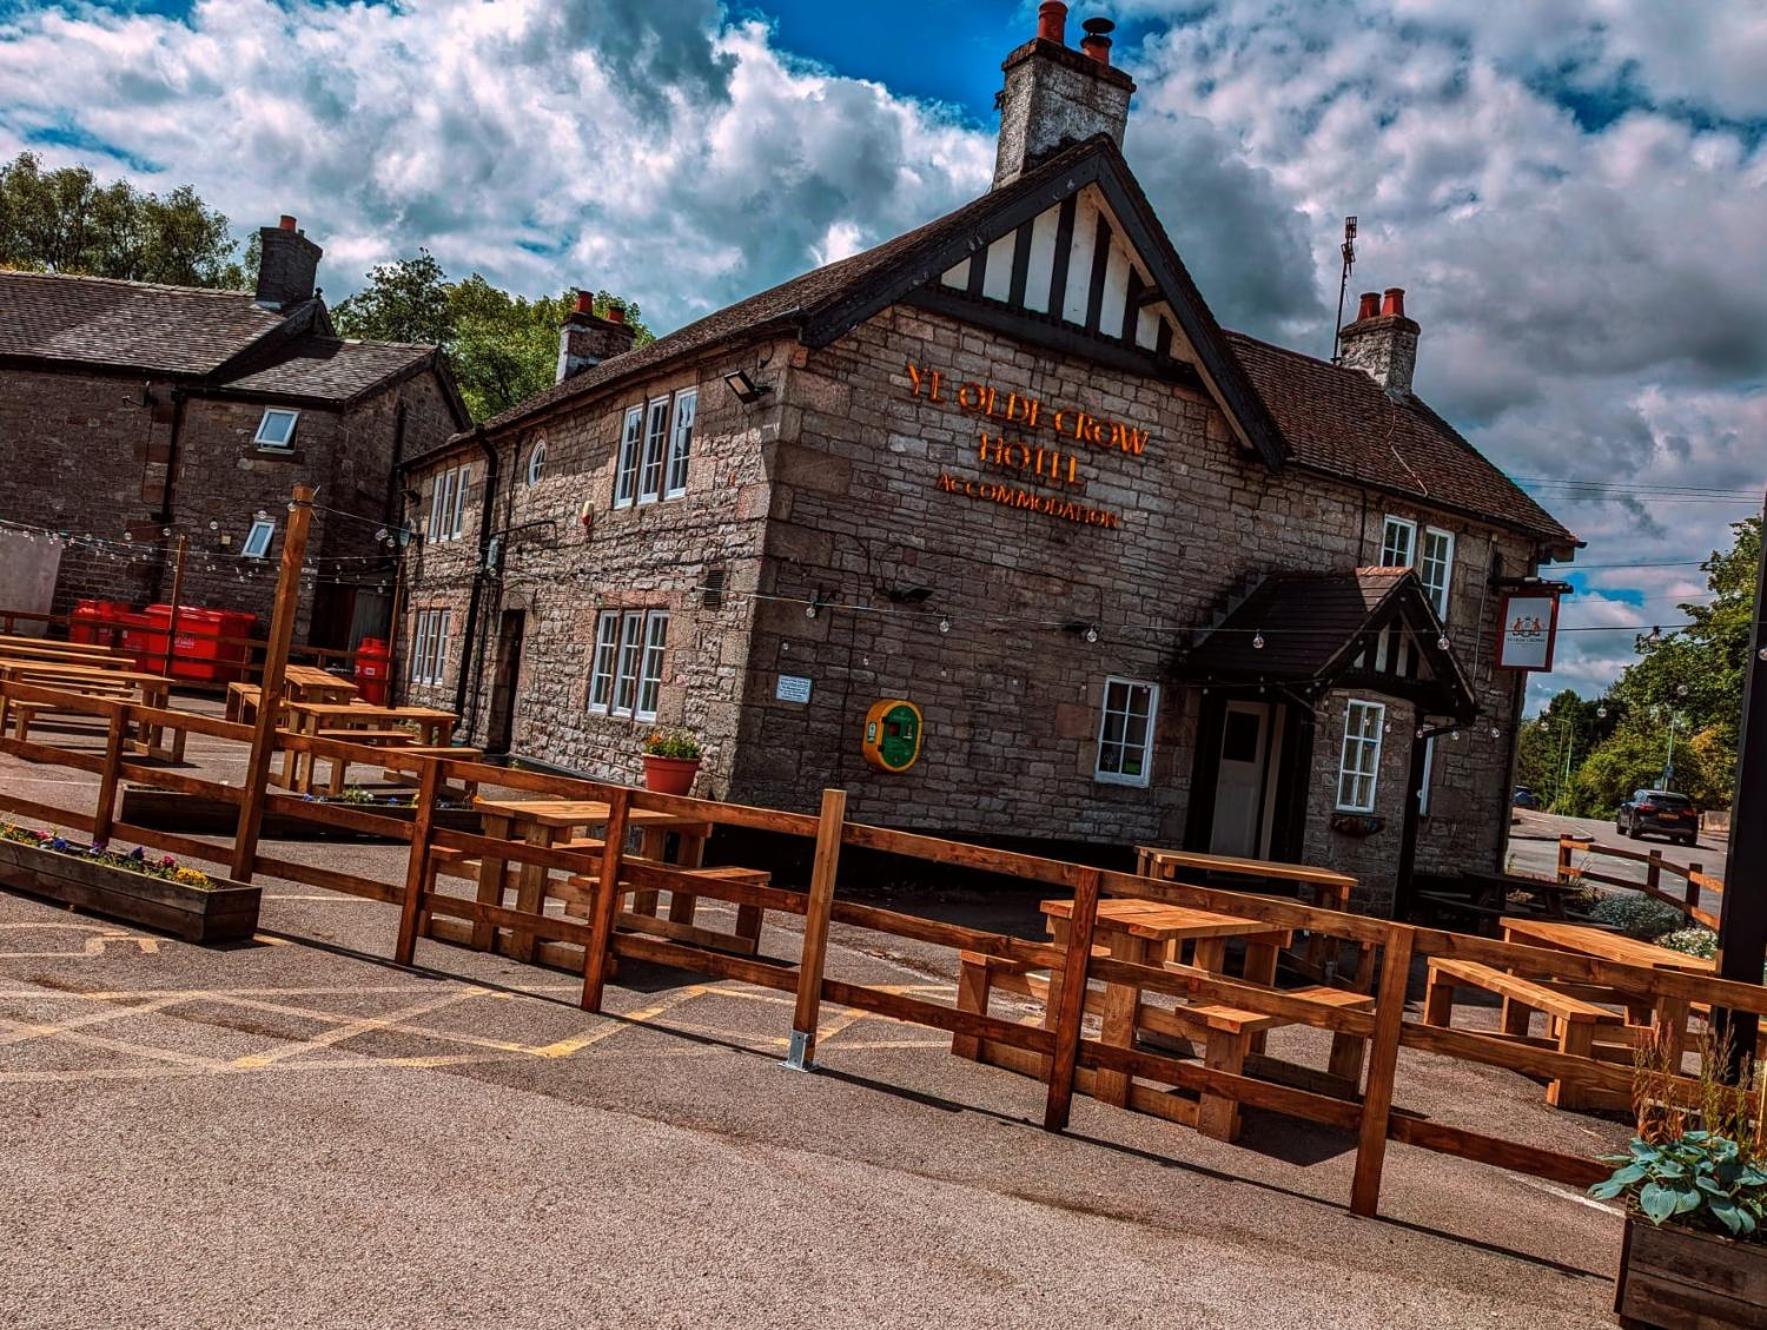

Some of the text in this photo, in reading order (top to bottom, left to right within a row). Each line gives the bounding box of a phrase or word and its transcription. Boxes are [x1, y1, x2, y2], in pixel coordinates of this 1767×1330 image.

[959, 381, 1043, 428] OLDE
[1054, 409, 1150, 456] CROW
[979, 431, 1084, 487] HOTEL
[936, 473, 1121, 530] ACCOMMODATION
